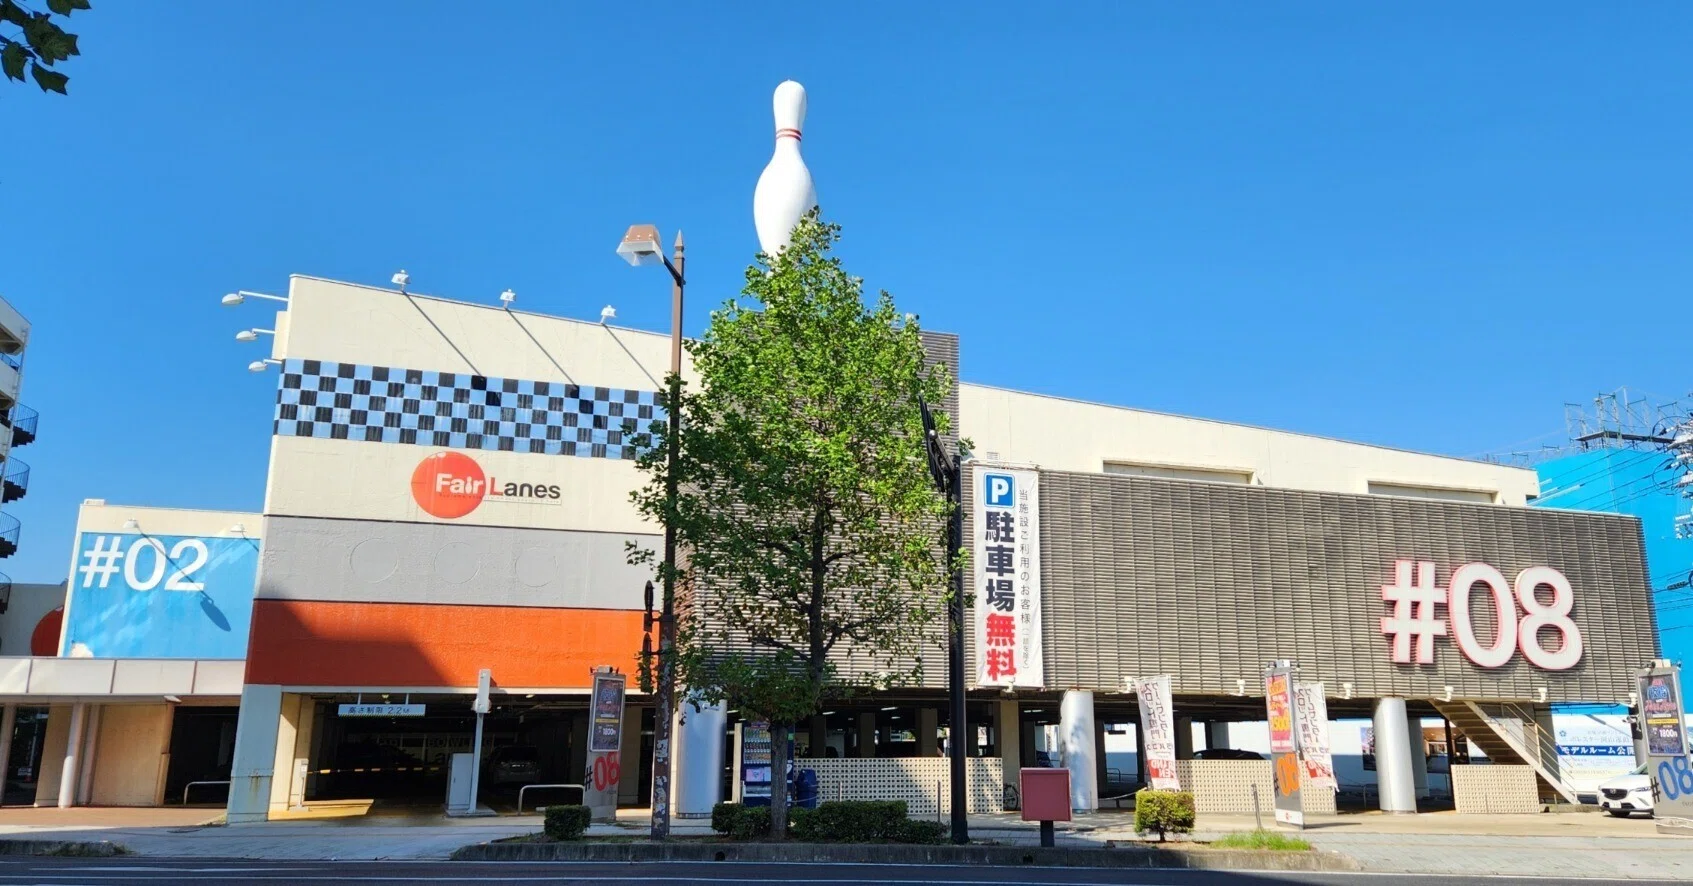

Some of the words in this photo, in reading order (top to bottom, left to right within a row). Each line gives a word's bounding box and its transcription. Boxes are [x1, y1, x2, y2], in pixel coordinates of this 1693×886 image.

[435, 473, 484, 495] Fair
[489, 477, 561, 500] Lanes
[991, 478, 1009, 504] P
[80, 535, 208, 591] #02
[985, 511, 1017, 681] 駐車場無料
[1380, 559, 1583, 670] #08
[584, 752, 621, 791] #08
[1650, 756, 1693, 803] #08
